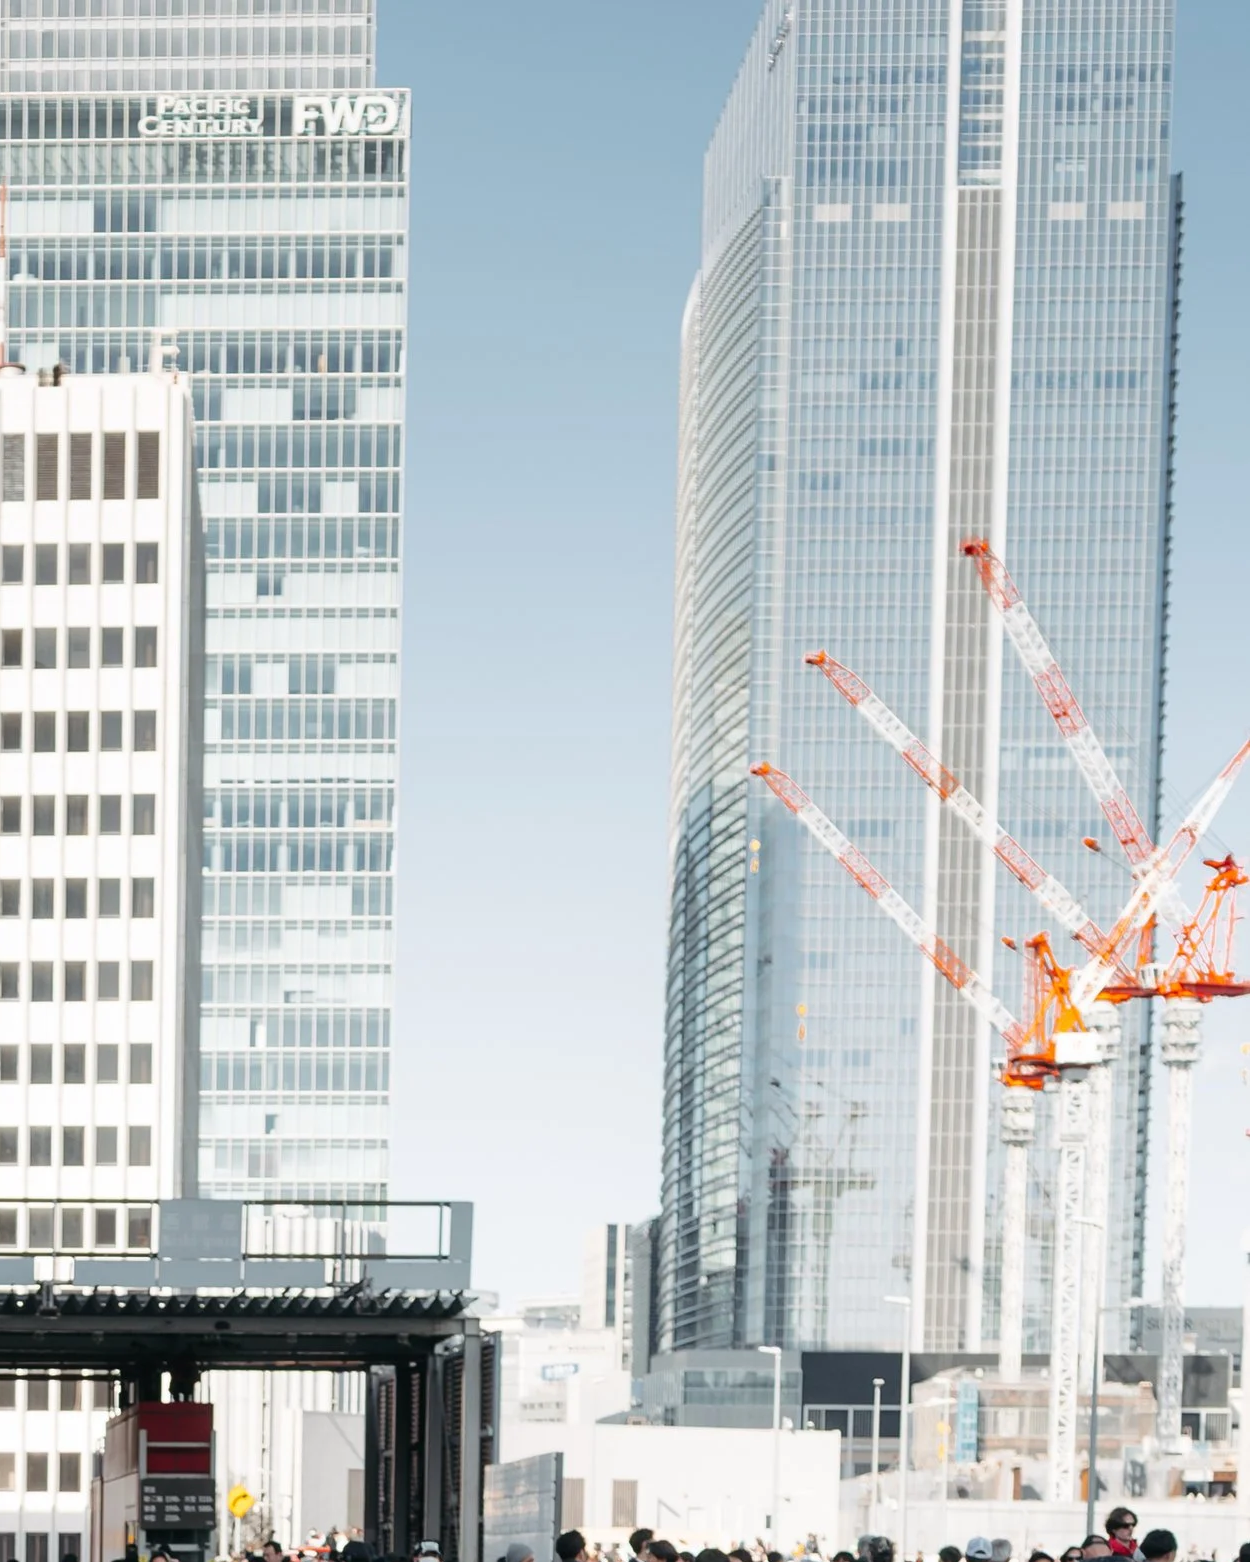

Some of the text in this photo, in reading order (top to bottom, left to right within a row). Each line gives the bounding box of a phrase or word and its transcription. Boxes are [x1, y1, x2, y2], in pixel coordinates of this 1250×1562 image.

[156, 95, 250, 114] PACIFIC
[293, 95, 398, 133] FWD
[138, 116, 263, 135] CENTURY
